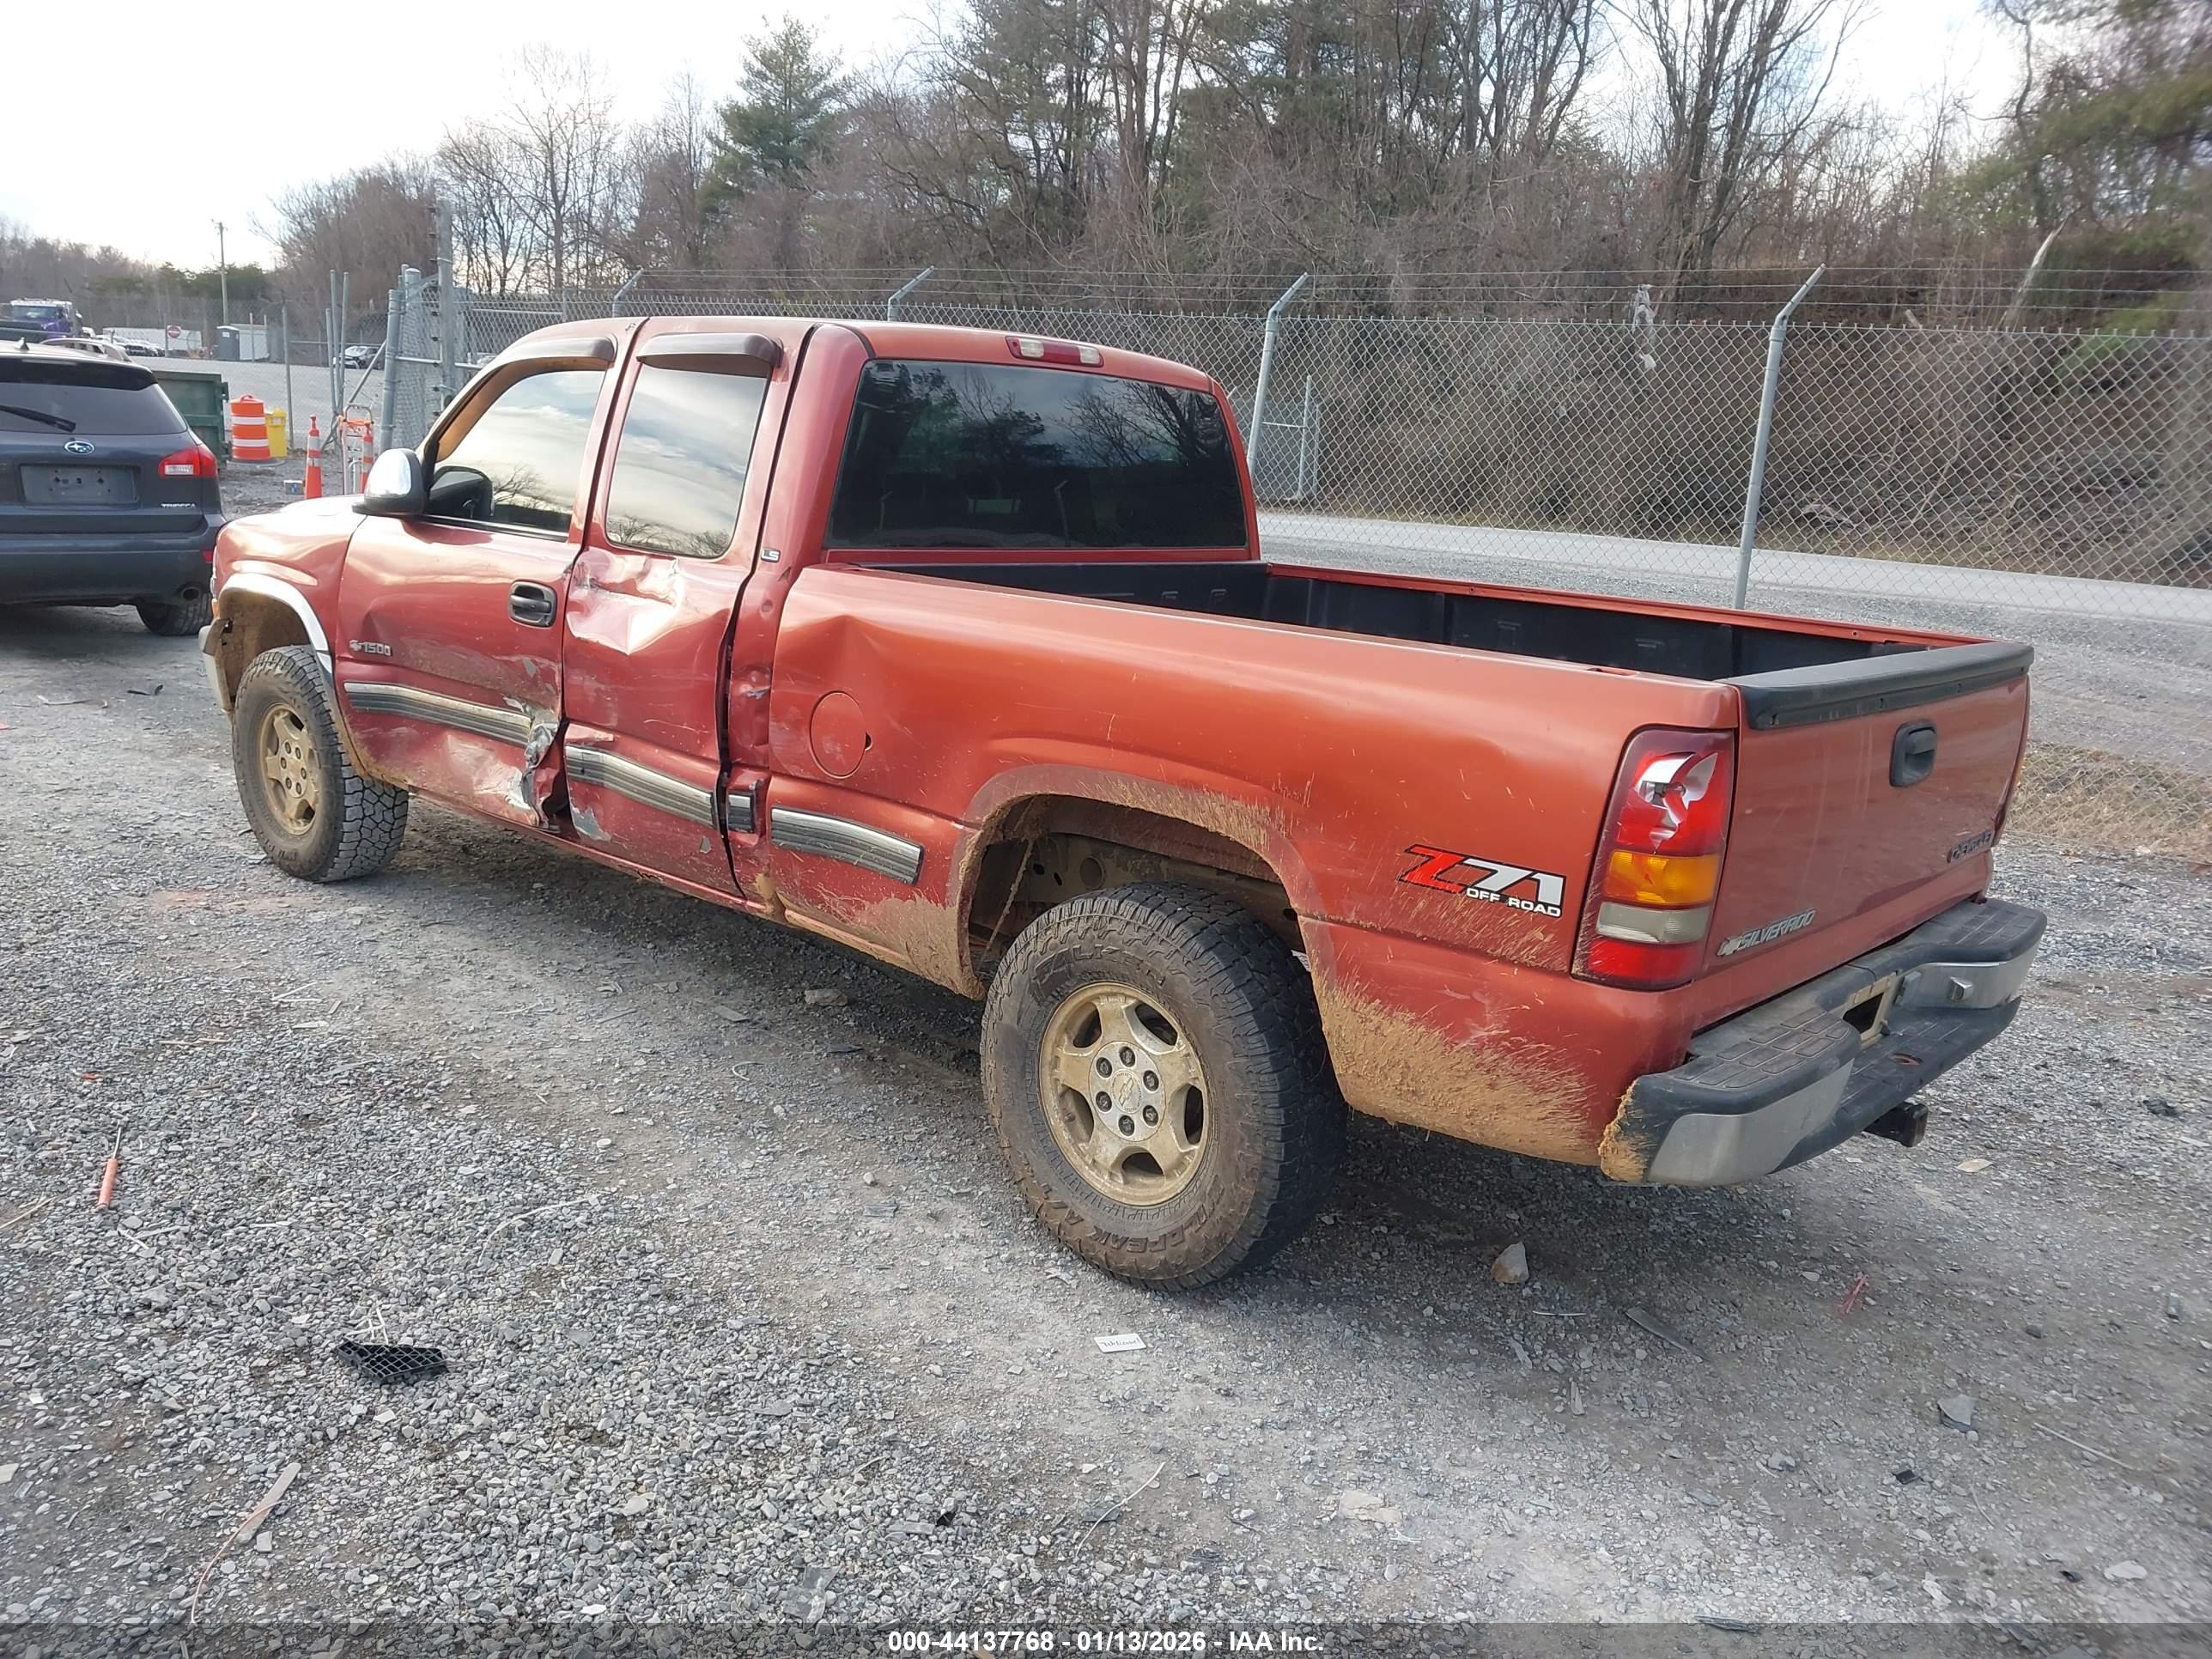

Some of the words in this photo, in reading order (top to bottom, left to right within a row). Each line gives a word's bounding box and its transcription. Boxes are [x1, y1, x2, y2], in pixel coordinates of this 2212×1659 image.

[761, 549, 780, 562] LS
[363, 641, 392, 656] 1500
[1398, 843, 1567, 908] Z71
[1466, 888, 1501, 902] OFF
[1507, 897, 1562, 918] ROAD
[1737, 909, 1817, 951] SILVERADO
